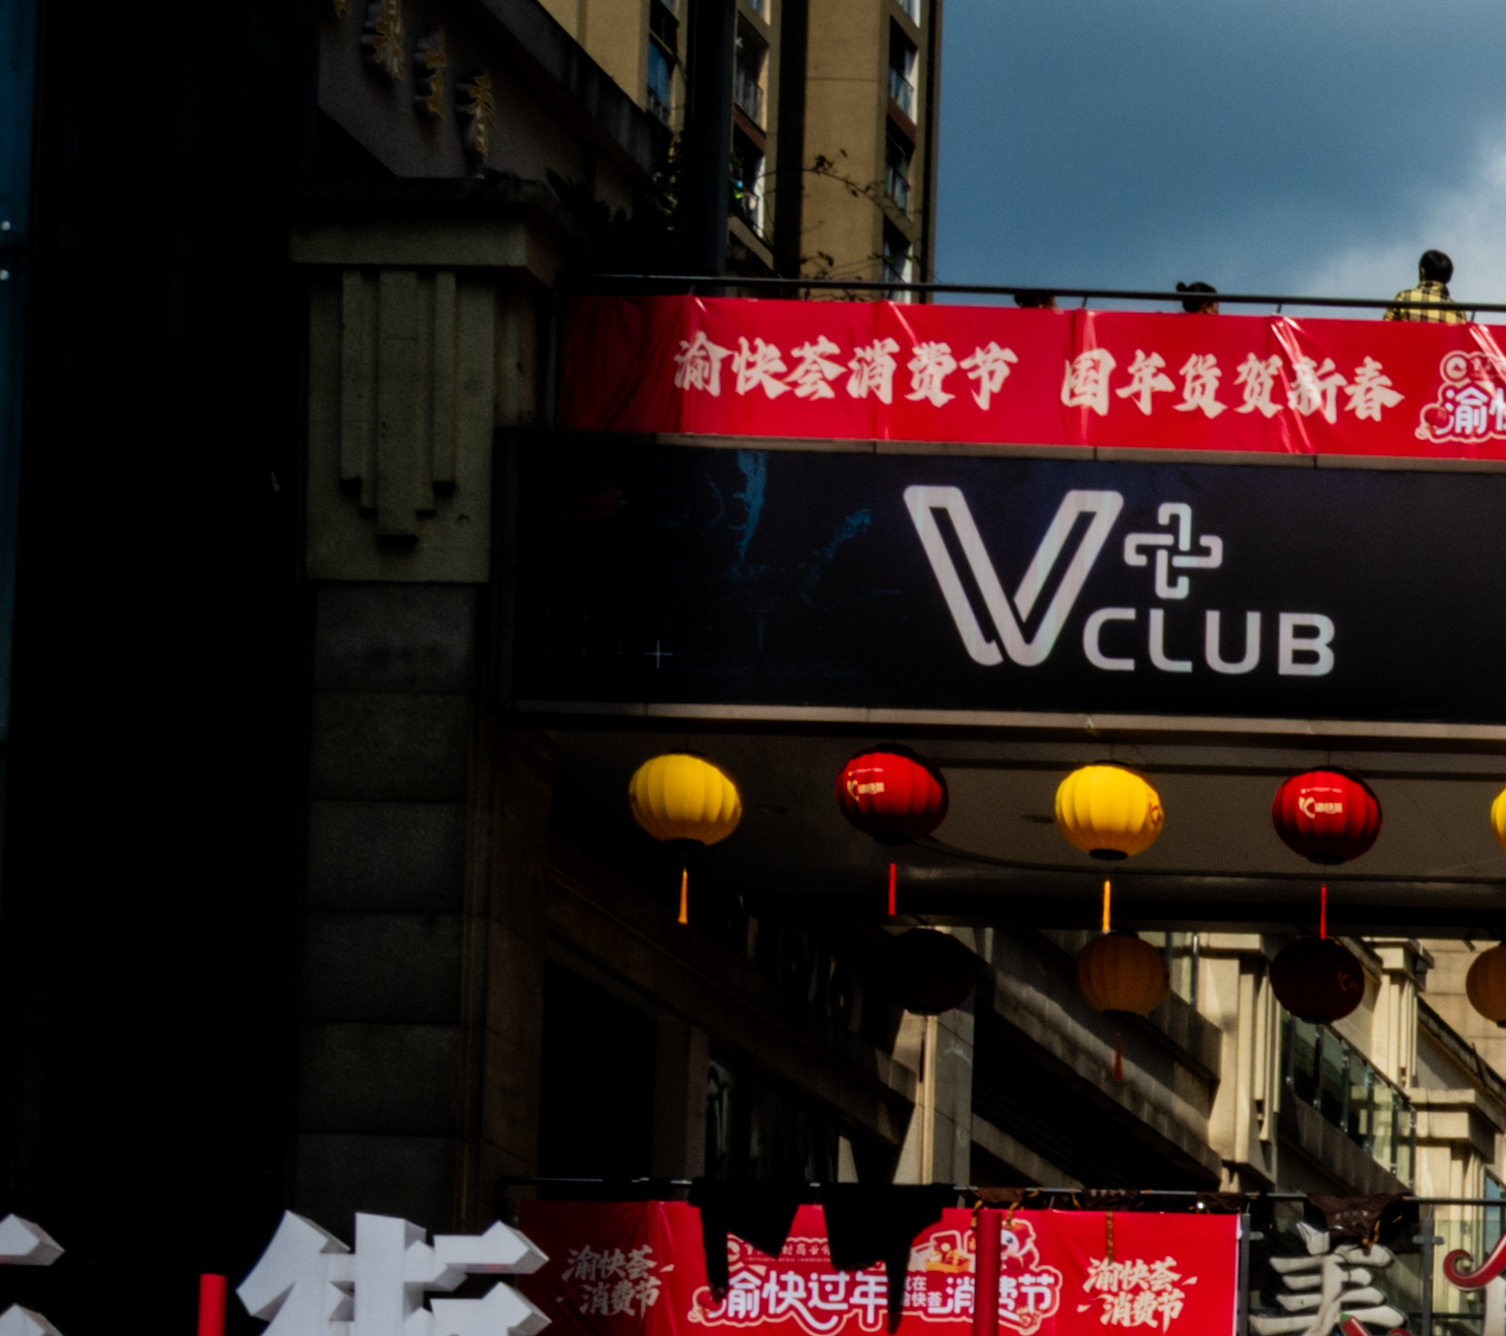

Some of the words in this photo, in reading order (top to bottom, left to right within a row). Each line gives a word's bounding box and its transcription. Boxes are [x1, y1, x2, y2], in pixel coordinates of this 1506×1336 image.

[674, 330, 1019, 411] 渝快荟消费节
[1082, 606, 1335, 676] CLUB
